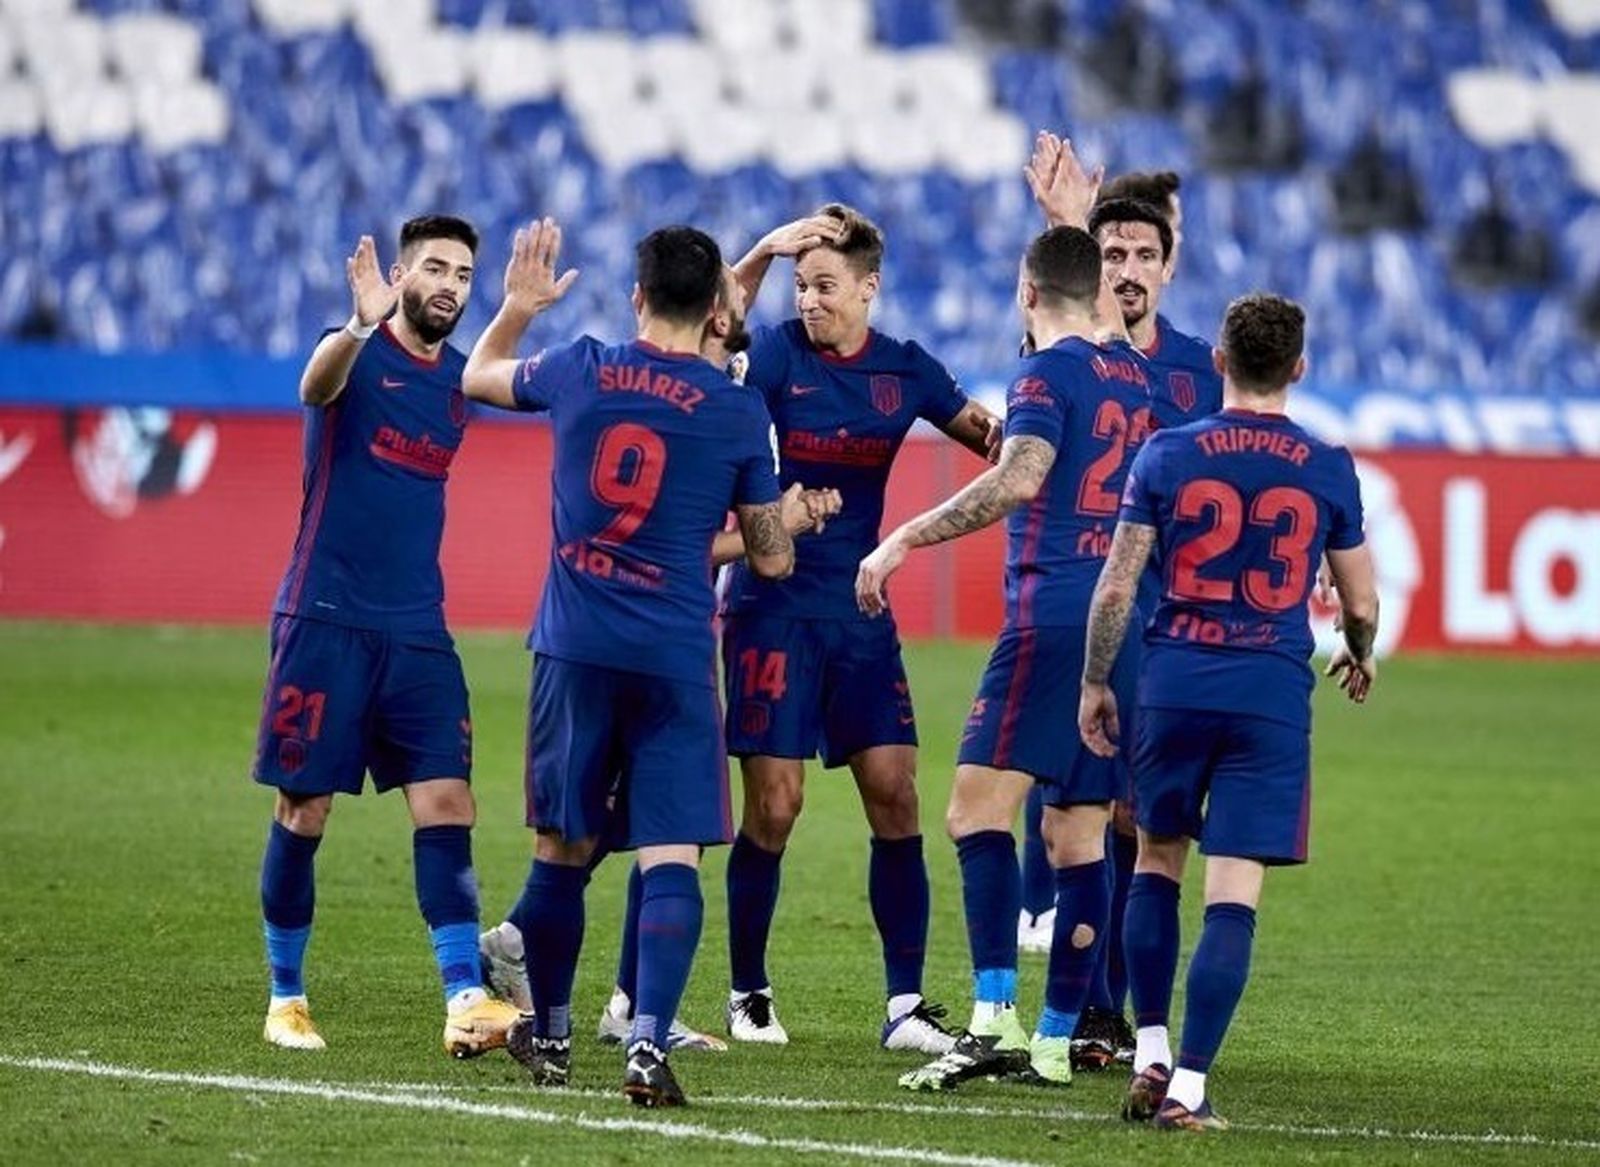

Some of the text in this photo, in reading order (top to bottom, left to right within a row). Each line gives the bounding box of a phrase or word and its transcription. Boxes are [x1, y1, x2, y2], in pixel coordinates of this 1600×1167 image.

[599, 363, 706, 415] SUÁREZ
[1195, 428, 1311, 467] TRIPPIER
[590, 423, 667, 546] 9
[1167, 478, 1318, 614] 23
[740, 649, 787, 700] 14
[271, 685, 327, 741] 21
